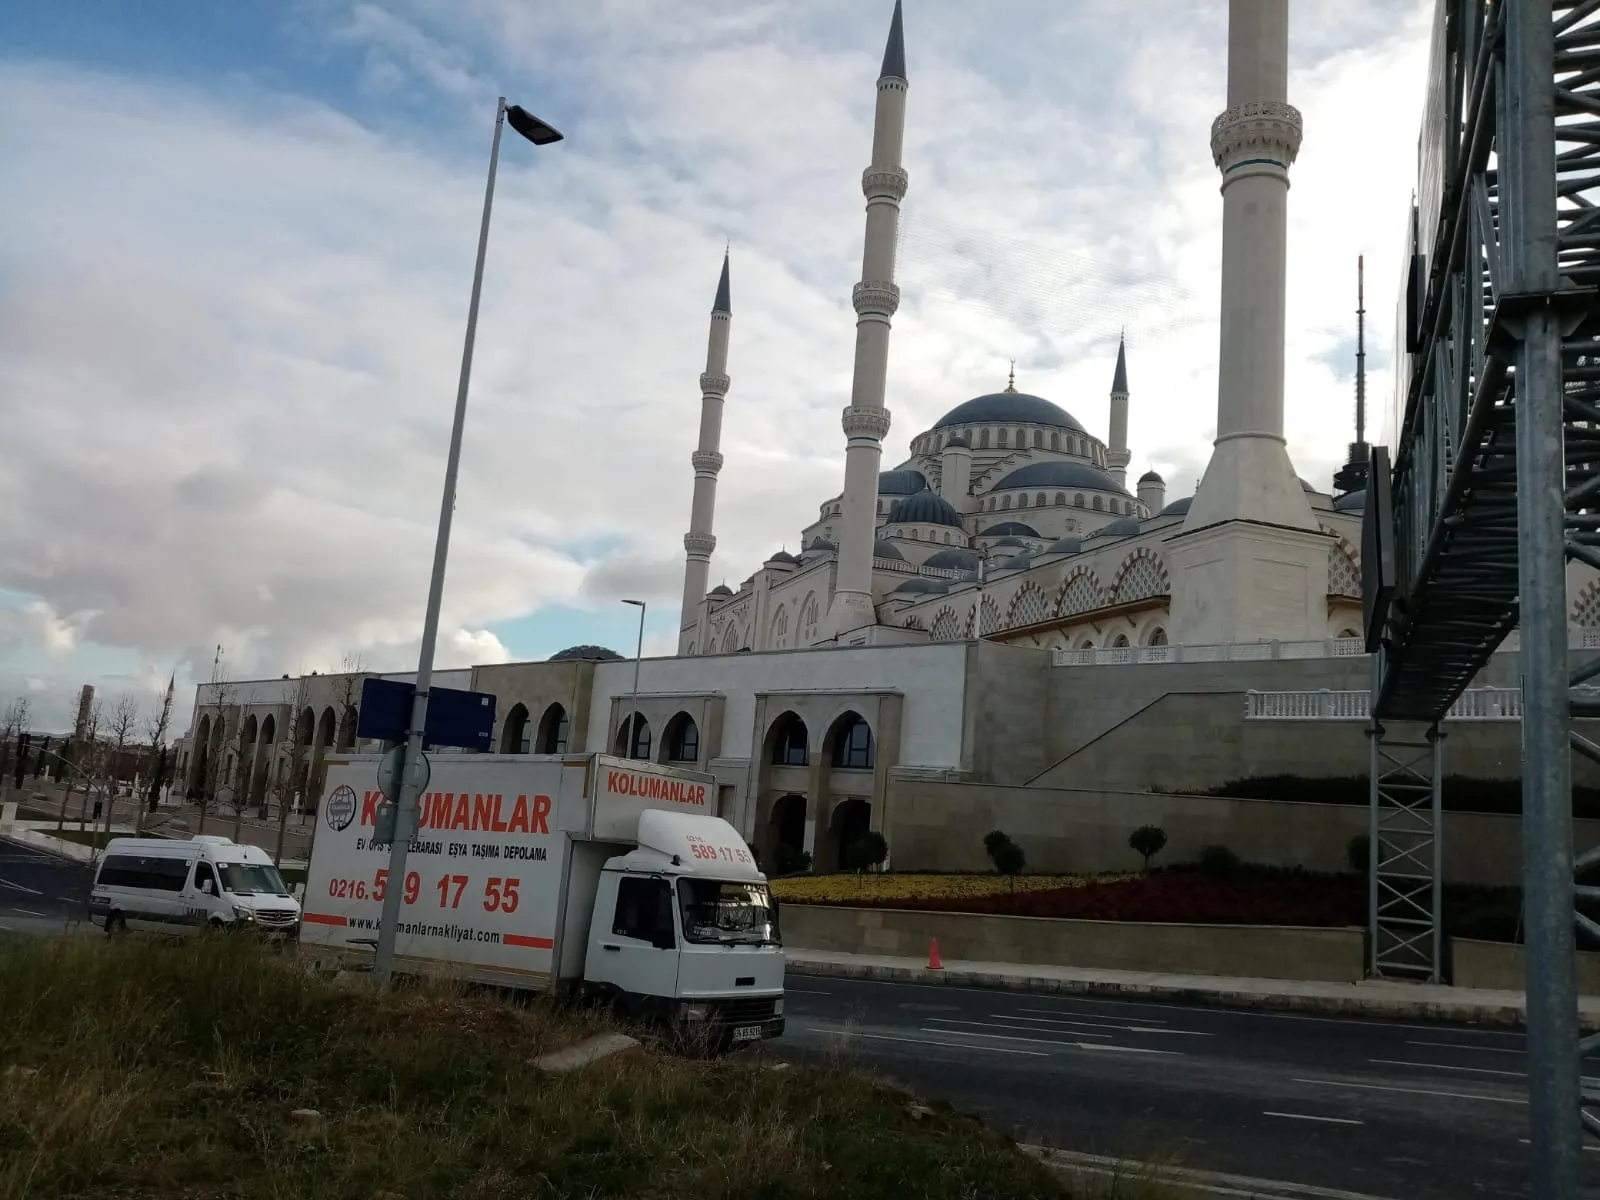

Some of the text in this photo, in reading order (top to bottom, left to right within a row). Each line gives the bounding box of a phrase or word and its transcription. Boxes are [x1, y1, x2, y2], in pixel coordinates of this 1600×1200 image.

[607, 771, 705, 806] KOLUMANLAR
[360, 791, 552, 834] KUMANLAR
[356, 838, 366, 850] EV
[448, 843, 468, 858] EŞYA
[472, 843, 500, 859] TAŞIMA
[503, 845, 547, 861] DEPOLAMA
[690, 843, 752, 864] 589 17 55
[372, 868, 420, 905] 59
[436, 873, 468, 909] 17
[483, 877, 521, 914] 55
[349, 917, 500, 944] www.kmanlarnakliyat.com
